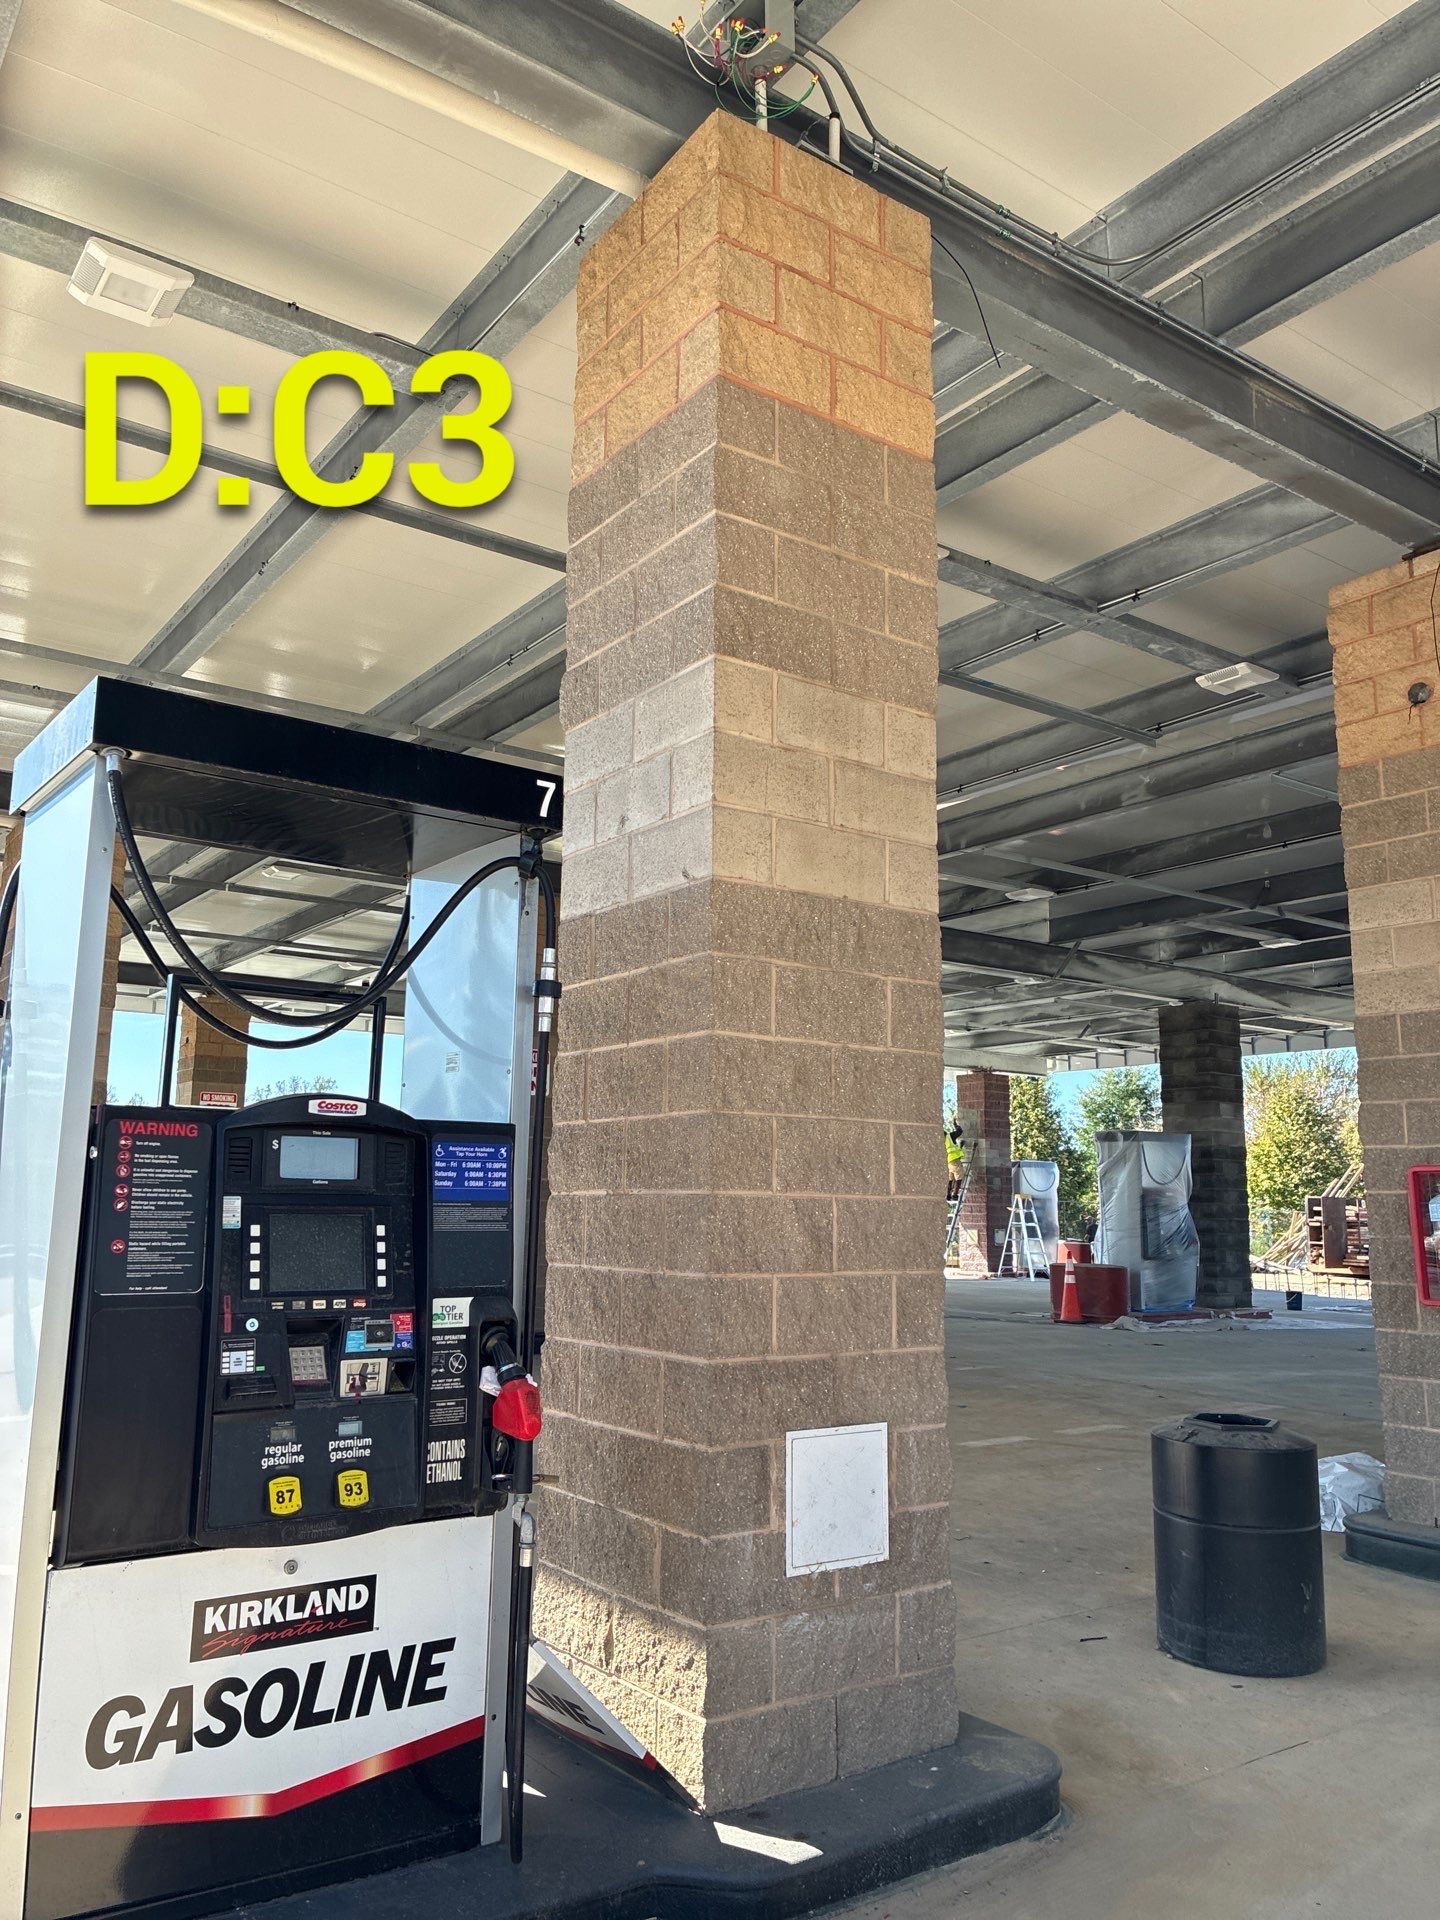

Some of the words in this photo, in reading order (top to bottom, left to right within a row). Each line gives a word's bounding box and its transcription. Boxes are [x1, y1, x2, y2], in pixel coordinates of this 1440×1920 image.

[536, 779, 556, 818] 7
[202, 1093, 211, 1101] NO
[211, 1094, 235, 1103] SMOKING
[317, 1100, 358, 1111] COSTCO
[120, 1120, 199, 1137] WARNING
[272, 1139, 279, 1150] $
[435, 1170, 457, 1178] Saturday
[440, 1304, 457, 1313] TOP
[446, 1312, 464, 1321] TIER
[264, 1441, 302, 1458] regular
[328, 1436, 372, 1452] premium
[261, 1453, 305, 1470] gasoline
[329, 1447, 371, 1463] gasoline
[426, 1461, 462, 1484] ETHANOL
[275, 1488, 295, 1505] 87
[344, 1481, 364, 1497] 93
[203, 1583, 370, 1635] KIRKLAND
[202, 1617, 368, 1658] Signature
[85, 1637, 457, 1770] GASOLINE
